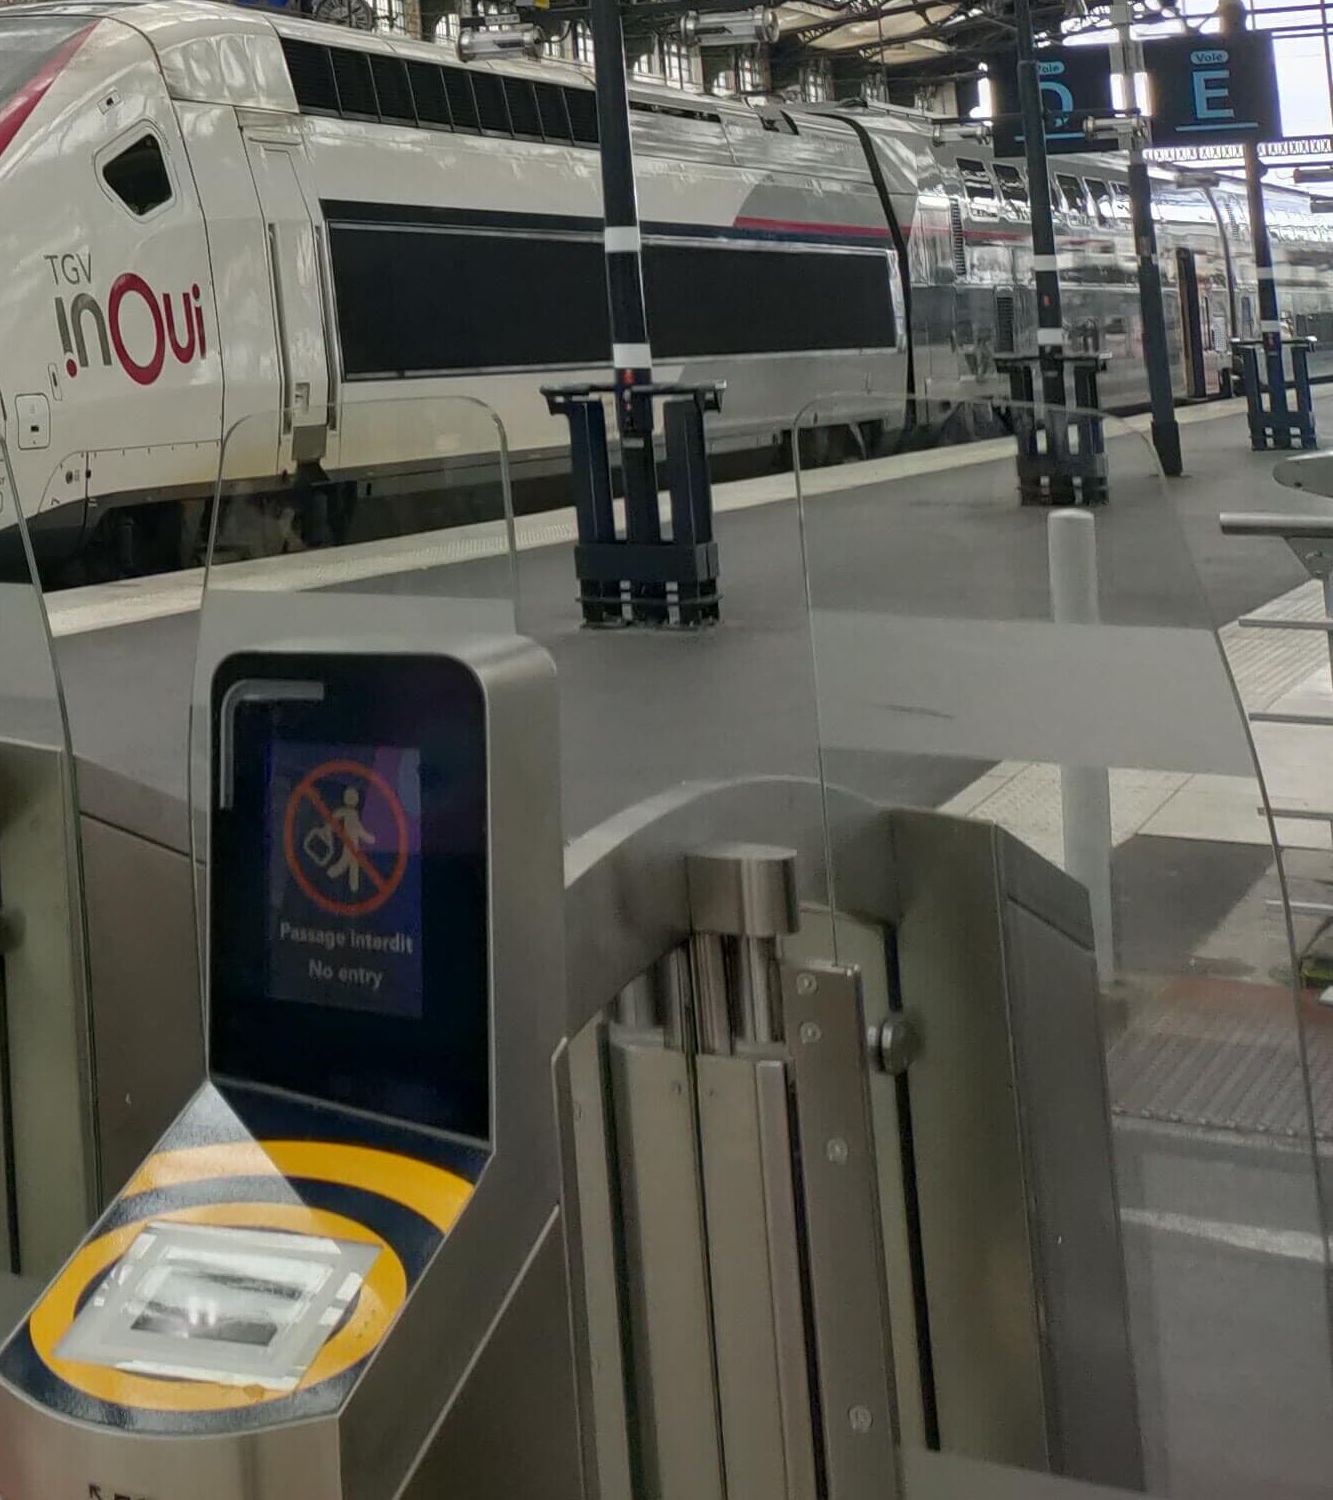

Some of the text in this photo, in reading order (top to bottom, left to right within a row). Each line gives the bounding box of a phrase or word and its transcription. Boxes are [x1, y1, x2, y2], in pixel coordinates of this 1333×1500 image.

[1193, 69, 1235, 119] E
[44, 251, 92, 286] TGV
[279, 921, 414, 955] Passage interdit
[308, 958, 385, 992] No entry
